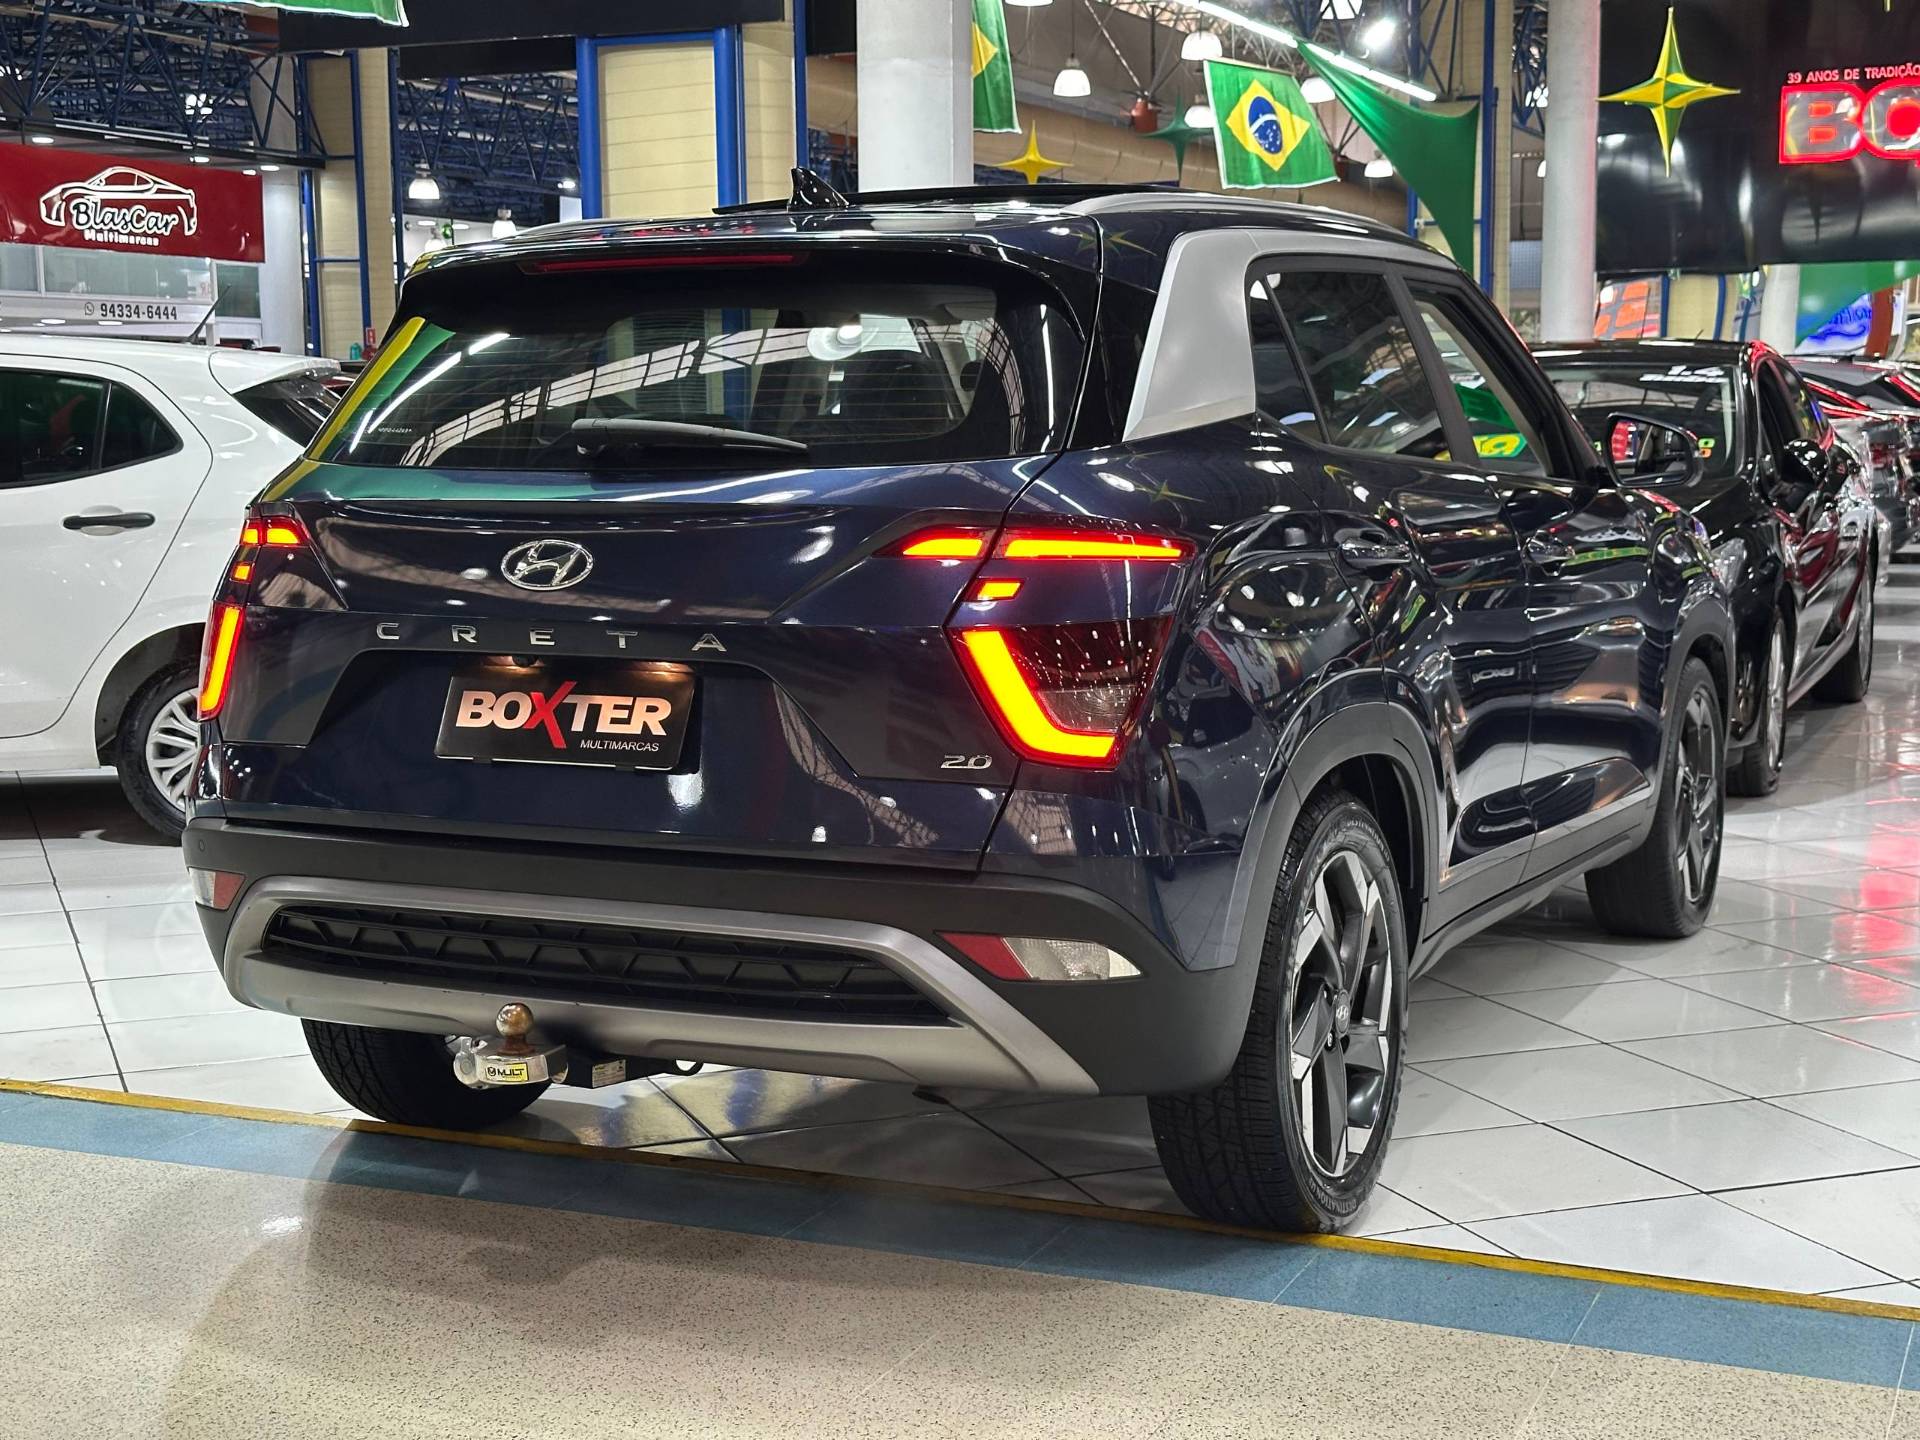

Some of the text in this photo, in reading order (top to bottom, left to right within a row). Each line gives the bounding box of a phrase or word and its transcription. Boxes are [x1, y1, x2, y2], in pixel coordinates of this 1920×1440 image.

[1787, 62, 1920, 84] 39 ANOS DE TRADIÇÃO
[1779, 78, 1920, 166] BO
[70, 198, 179, 236] BlasCar
[100, 303, 178, 320] 94334-6444
[376, 622, 727, 652] CRETA
[455, 680, 672, 750] BOXTER
[580, 739, 660, 752] MULTIMARCAS
